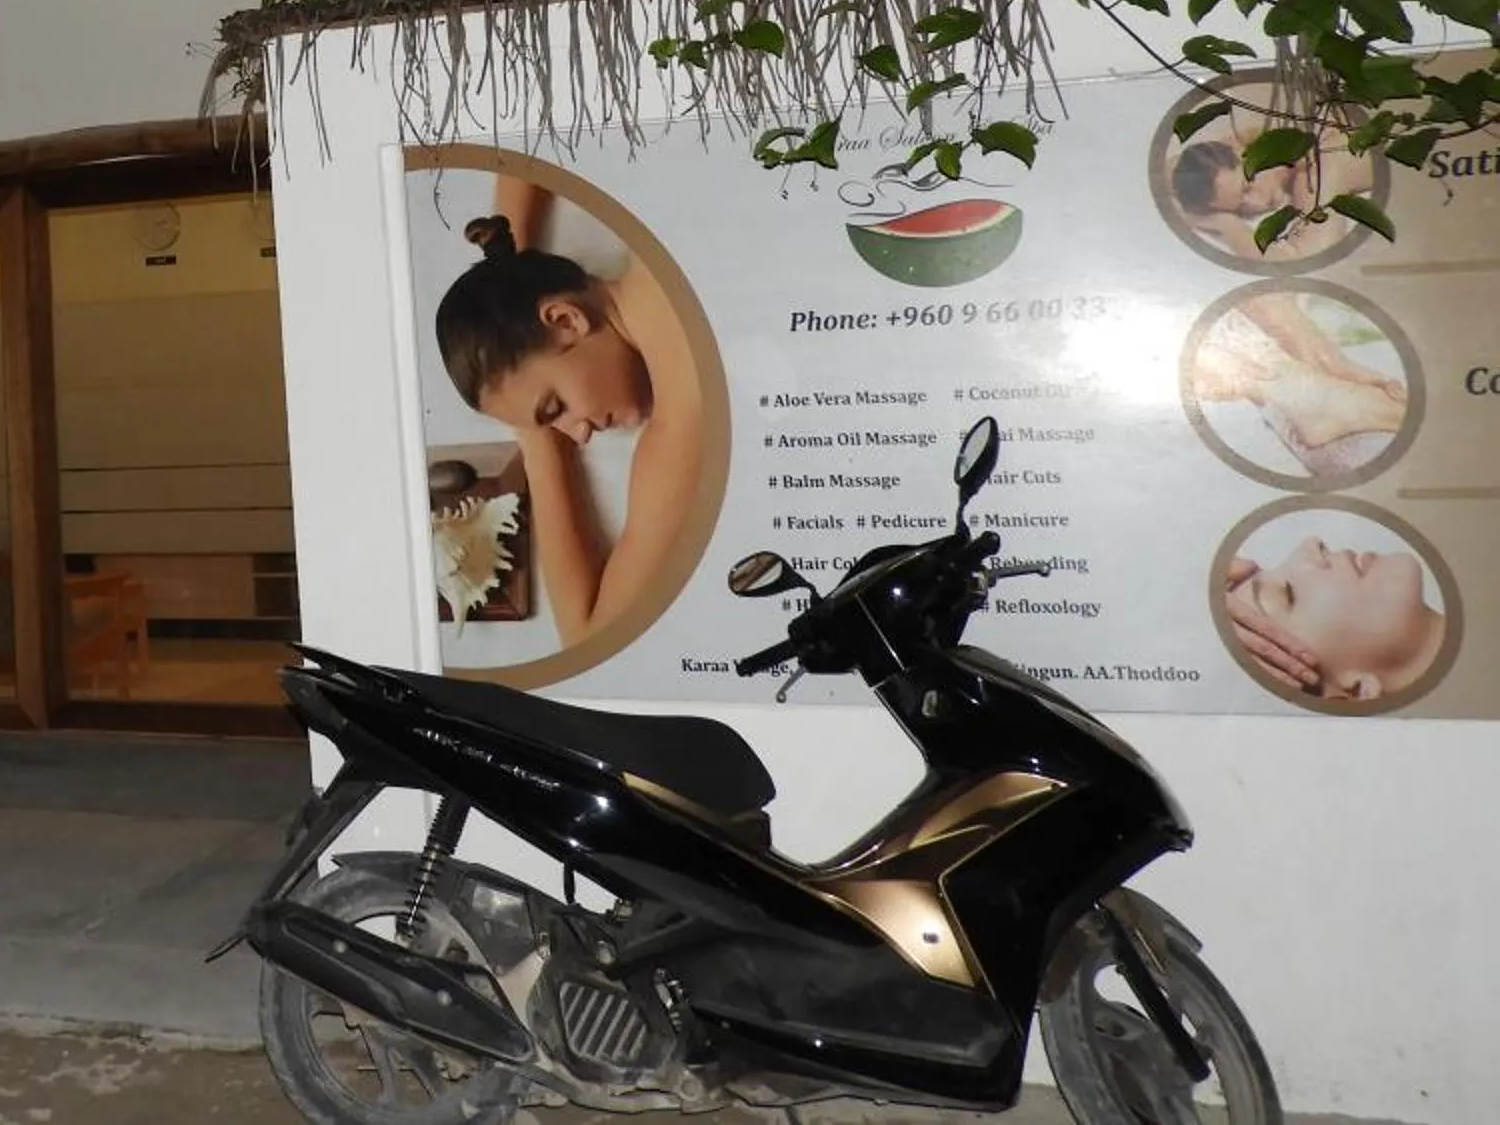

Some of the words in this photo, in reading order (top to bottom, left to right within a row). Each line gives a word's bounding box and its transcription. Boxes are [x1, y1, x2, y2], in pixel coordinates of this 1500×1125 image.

[790, 310, 877, 332] Phone:
[886, 304, 953, 326] +960
[962, 302, 977, 324] 9
[986, 302, 1020, 323] 66
[773, 393, 811, 408] Aloe
[813, 392, 851, 406] Vera
[855, 391, 928, 406] Massage
[777, 434, 833, 448] Aroma
[837, 432, 861, 446] Oil
[865, 432, 937, 448] Massage
[1017, 428, 1095, 444] Massage
[783, 475, 825, 489] Balm
[829, 474, 901, 490] Massage
[1022, 469, 1062, 484] Cuts
[787, 515, 844, 530] Facials
[871, 514, 947, 528] Pedicure
[985, 513, 1069, 528] Manicure
[792, 556, 829, 570] Hair
[681, 658, 730, 672] Karaa
[1083, 664, 1200, 681] AA.Thoddoo
